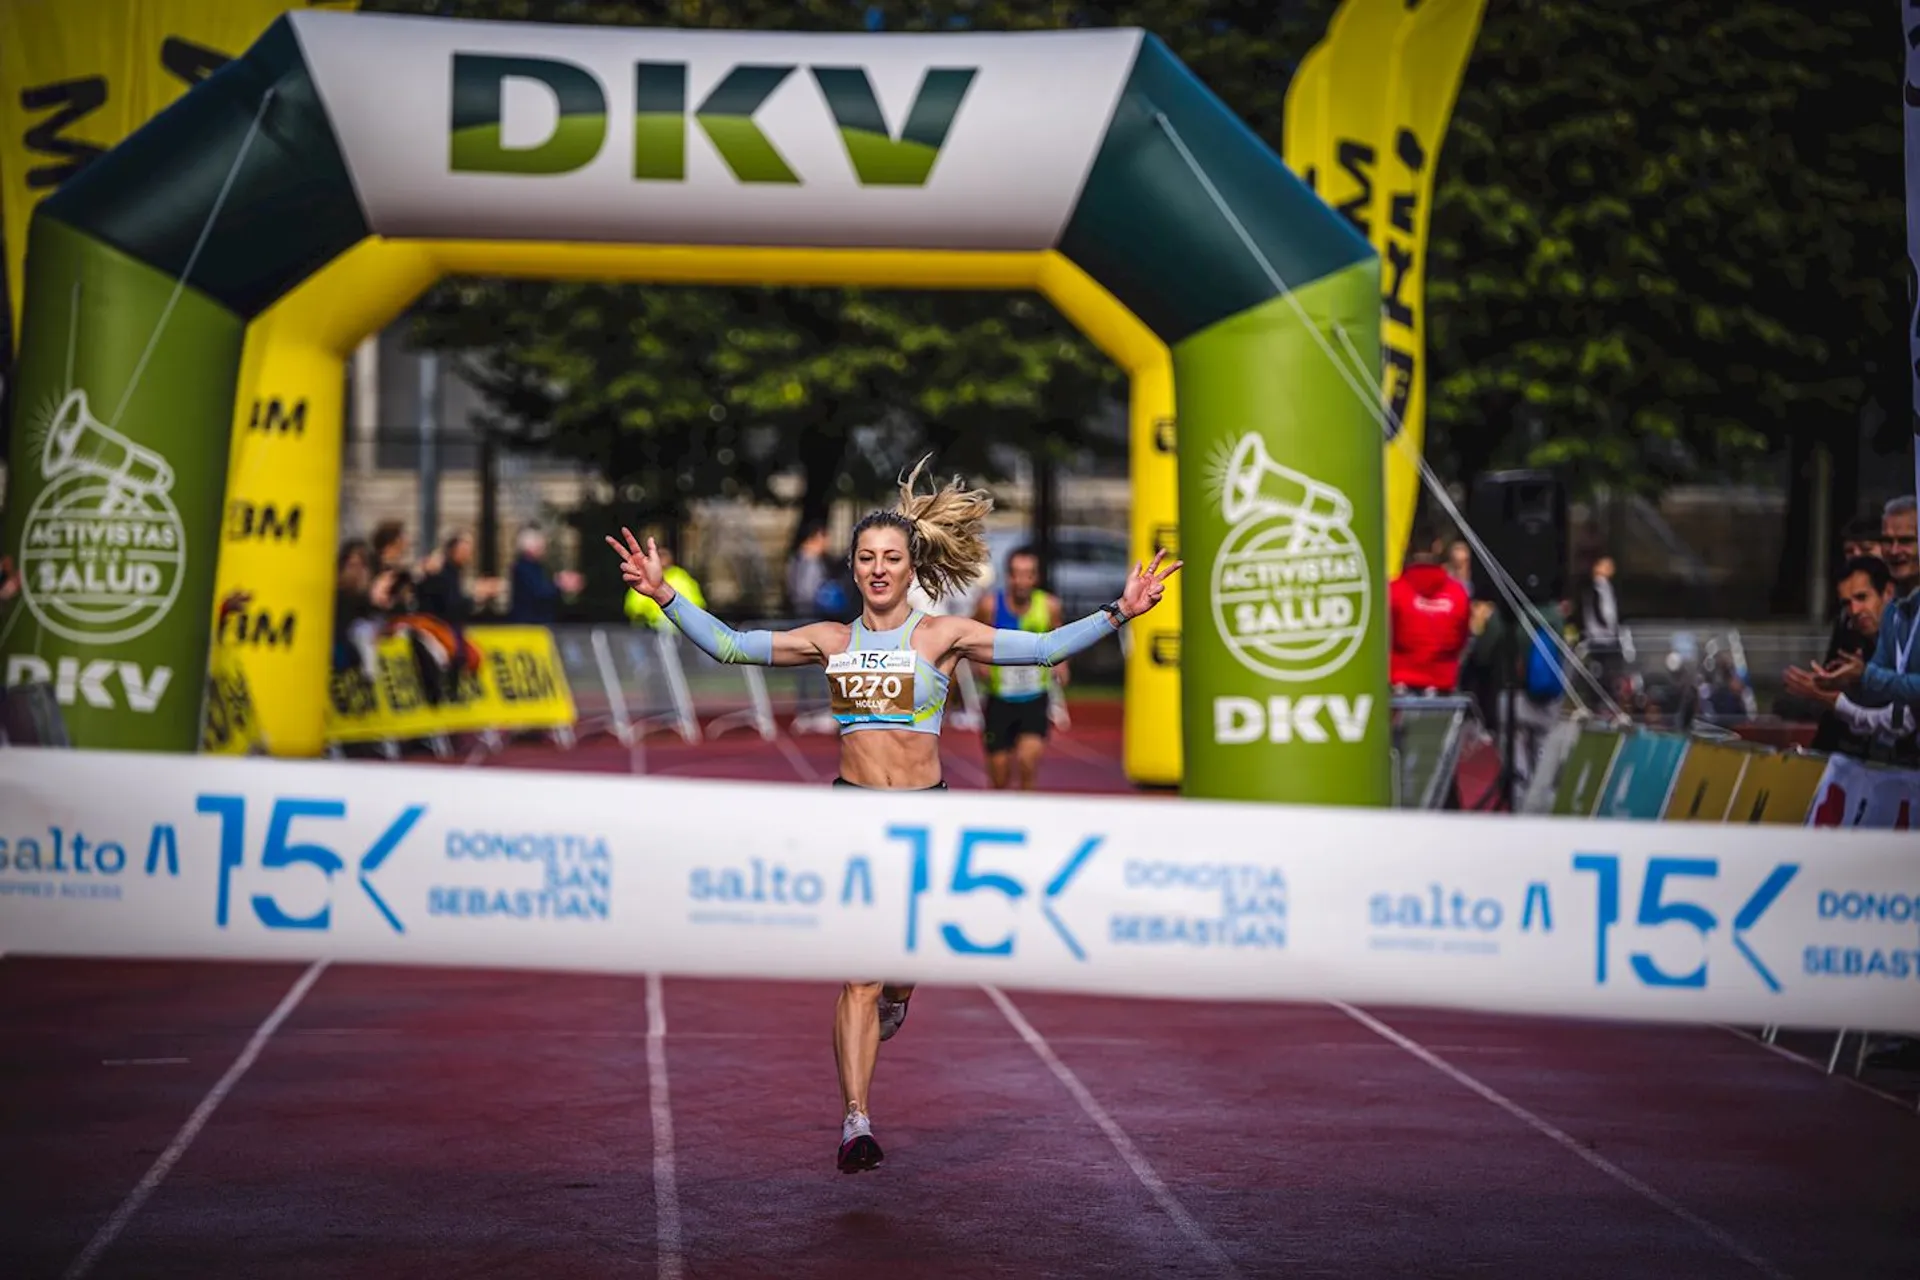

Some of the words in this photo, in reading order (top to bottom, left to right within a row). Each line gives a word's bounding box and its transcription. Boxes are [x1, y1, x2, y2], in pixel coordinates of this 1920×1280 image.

[448, 51, 981, 188] DKV
[30, 520, 176, 548] ACTIVISTAS
[38, 561, 162, 594] SALUD
[1222, 556, 1359, 589] ACTIVISTAS
[1234, 597, 1353, 634] SALUD
[6, 655, 173, 713] DKV
[837, 675, 902, 699] 1270
[1213, 694, 1373, 745] DKV
[445, 832, 611, 862] DONOSTIA
[689, 857, 824, 905] salto
[428, 888, 610, 919] SEBASTIAN
[1368, 882, 1503, 931] salto
[1109, 916, 1288, 948] SEBASTIAN
